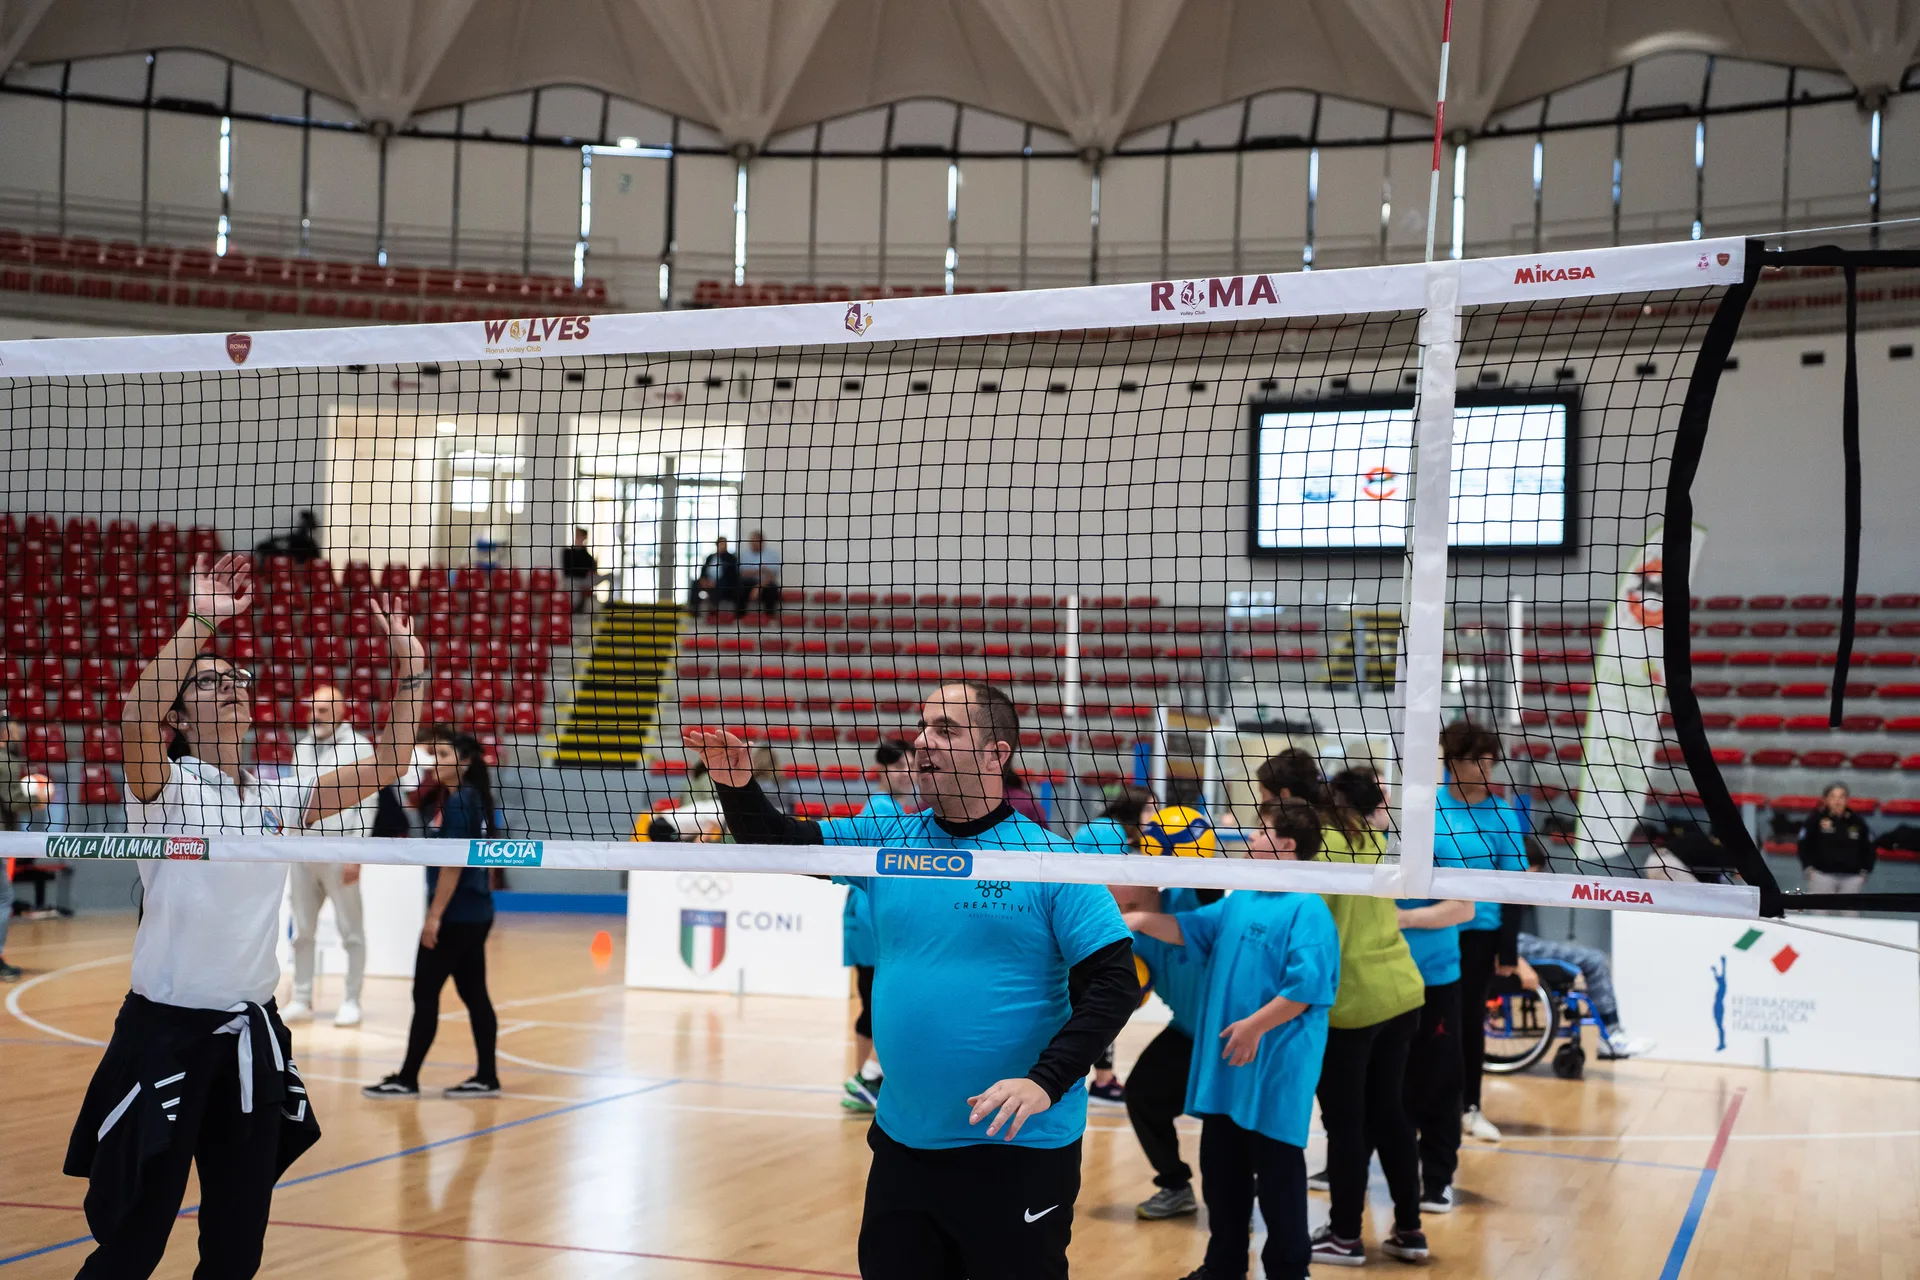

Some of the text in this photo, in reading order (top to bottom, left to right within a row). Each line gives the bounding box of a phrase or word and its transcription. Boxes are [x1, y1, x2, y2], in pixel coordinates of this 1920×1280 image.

[506, 345, 525, 354] Volley
[97, 834, 162, 859] MAMMA
[165, 839, 204, 856] Beretta
[884, 853, 965, 872] FINECO
[954, 901, 1031, 913] CREATTIVI
[736, 910, 802, 933] CONI
[1731, 995, 1816, 1010] FEDERAZIONE
